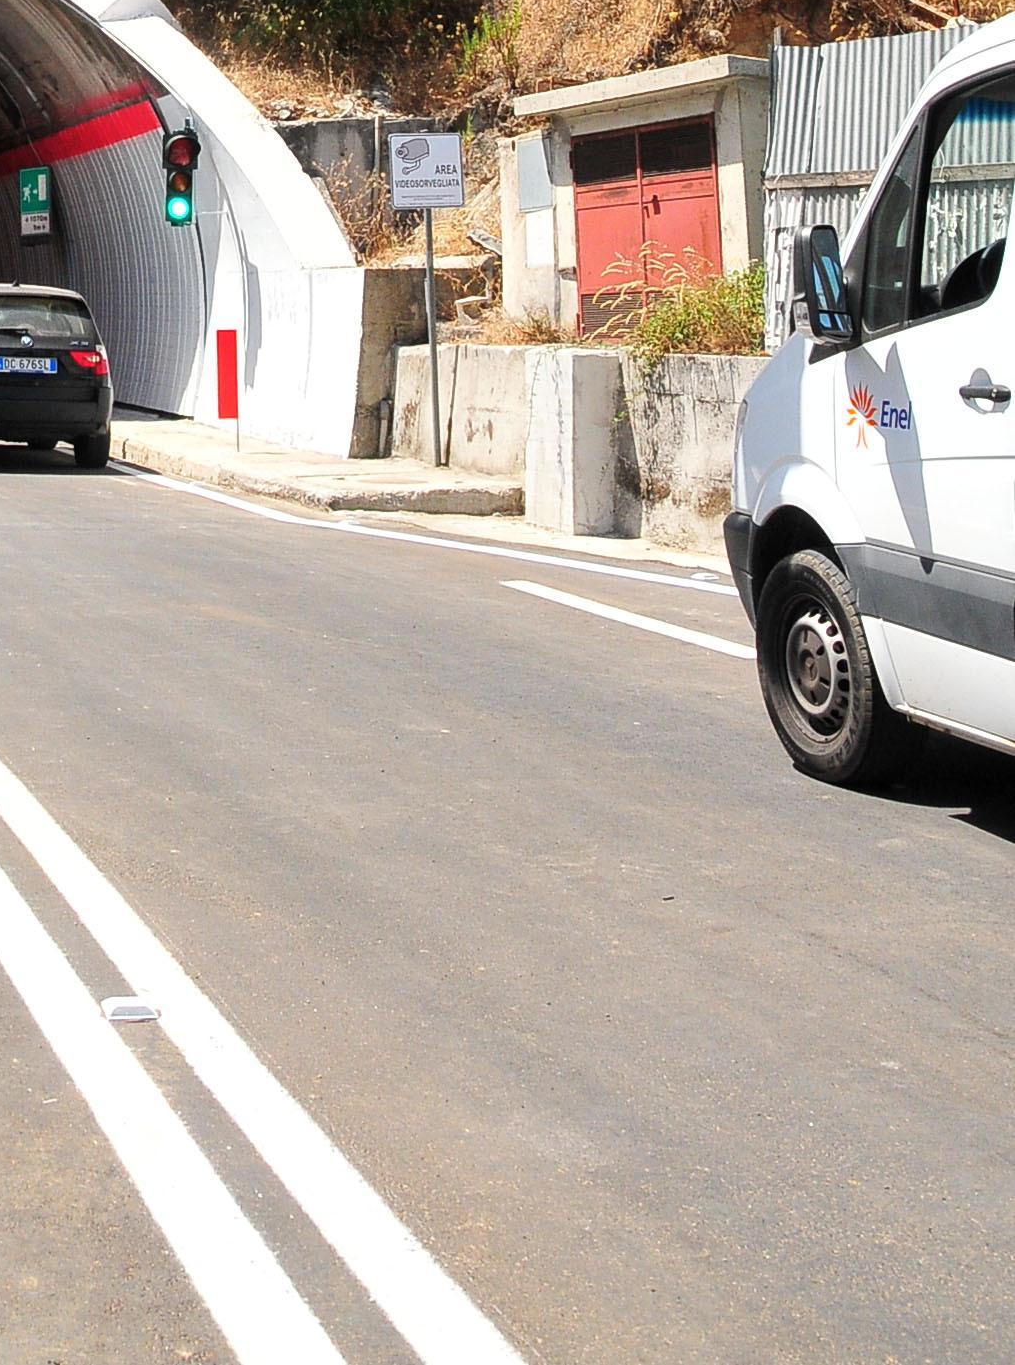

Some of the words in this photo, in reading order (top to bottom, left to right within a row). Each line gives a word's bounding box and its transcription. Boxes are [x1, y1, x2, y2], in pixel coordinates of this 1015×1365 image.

[434, 164, 458, 175] AREA
[394, 178, 460, 189] VIDEOSORVEGLIATA
[880, 400, 912, 430] Enel
